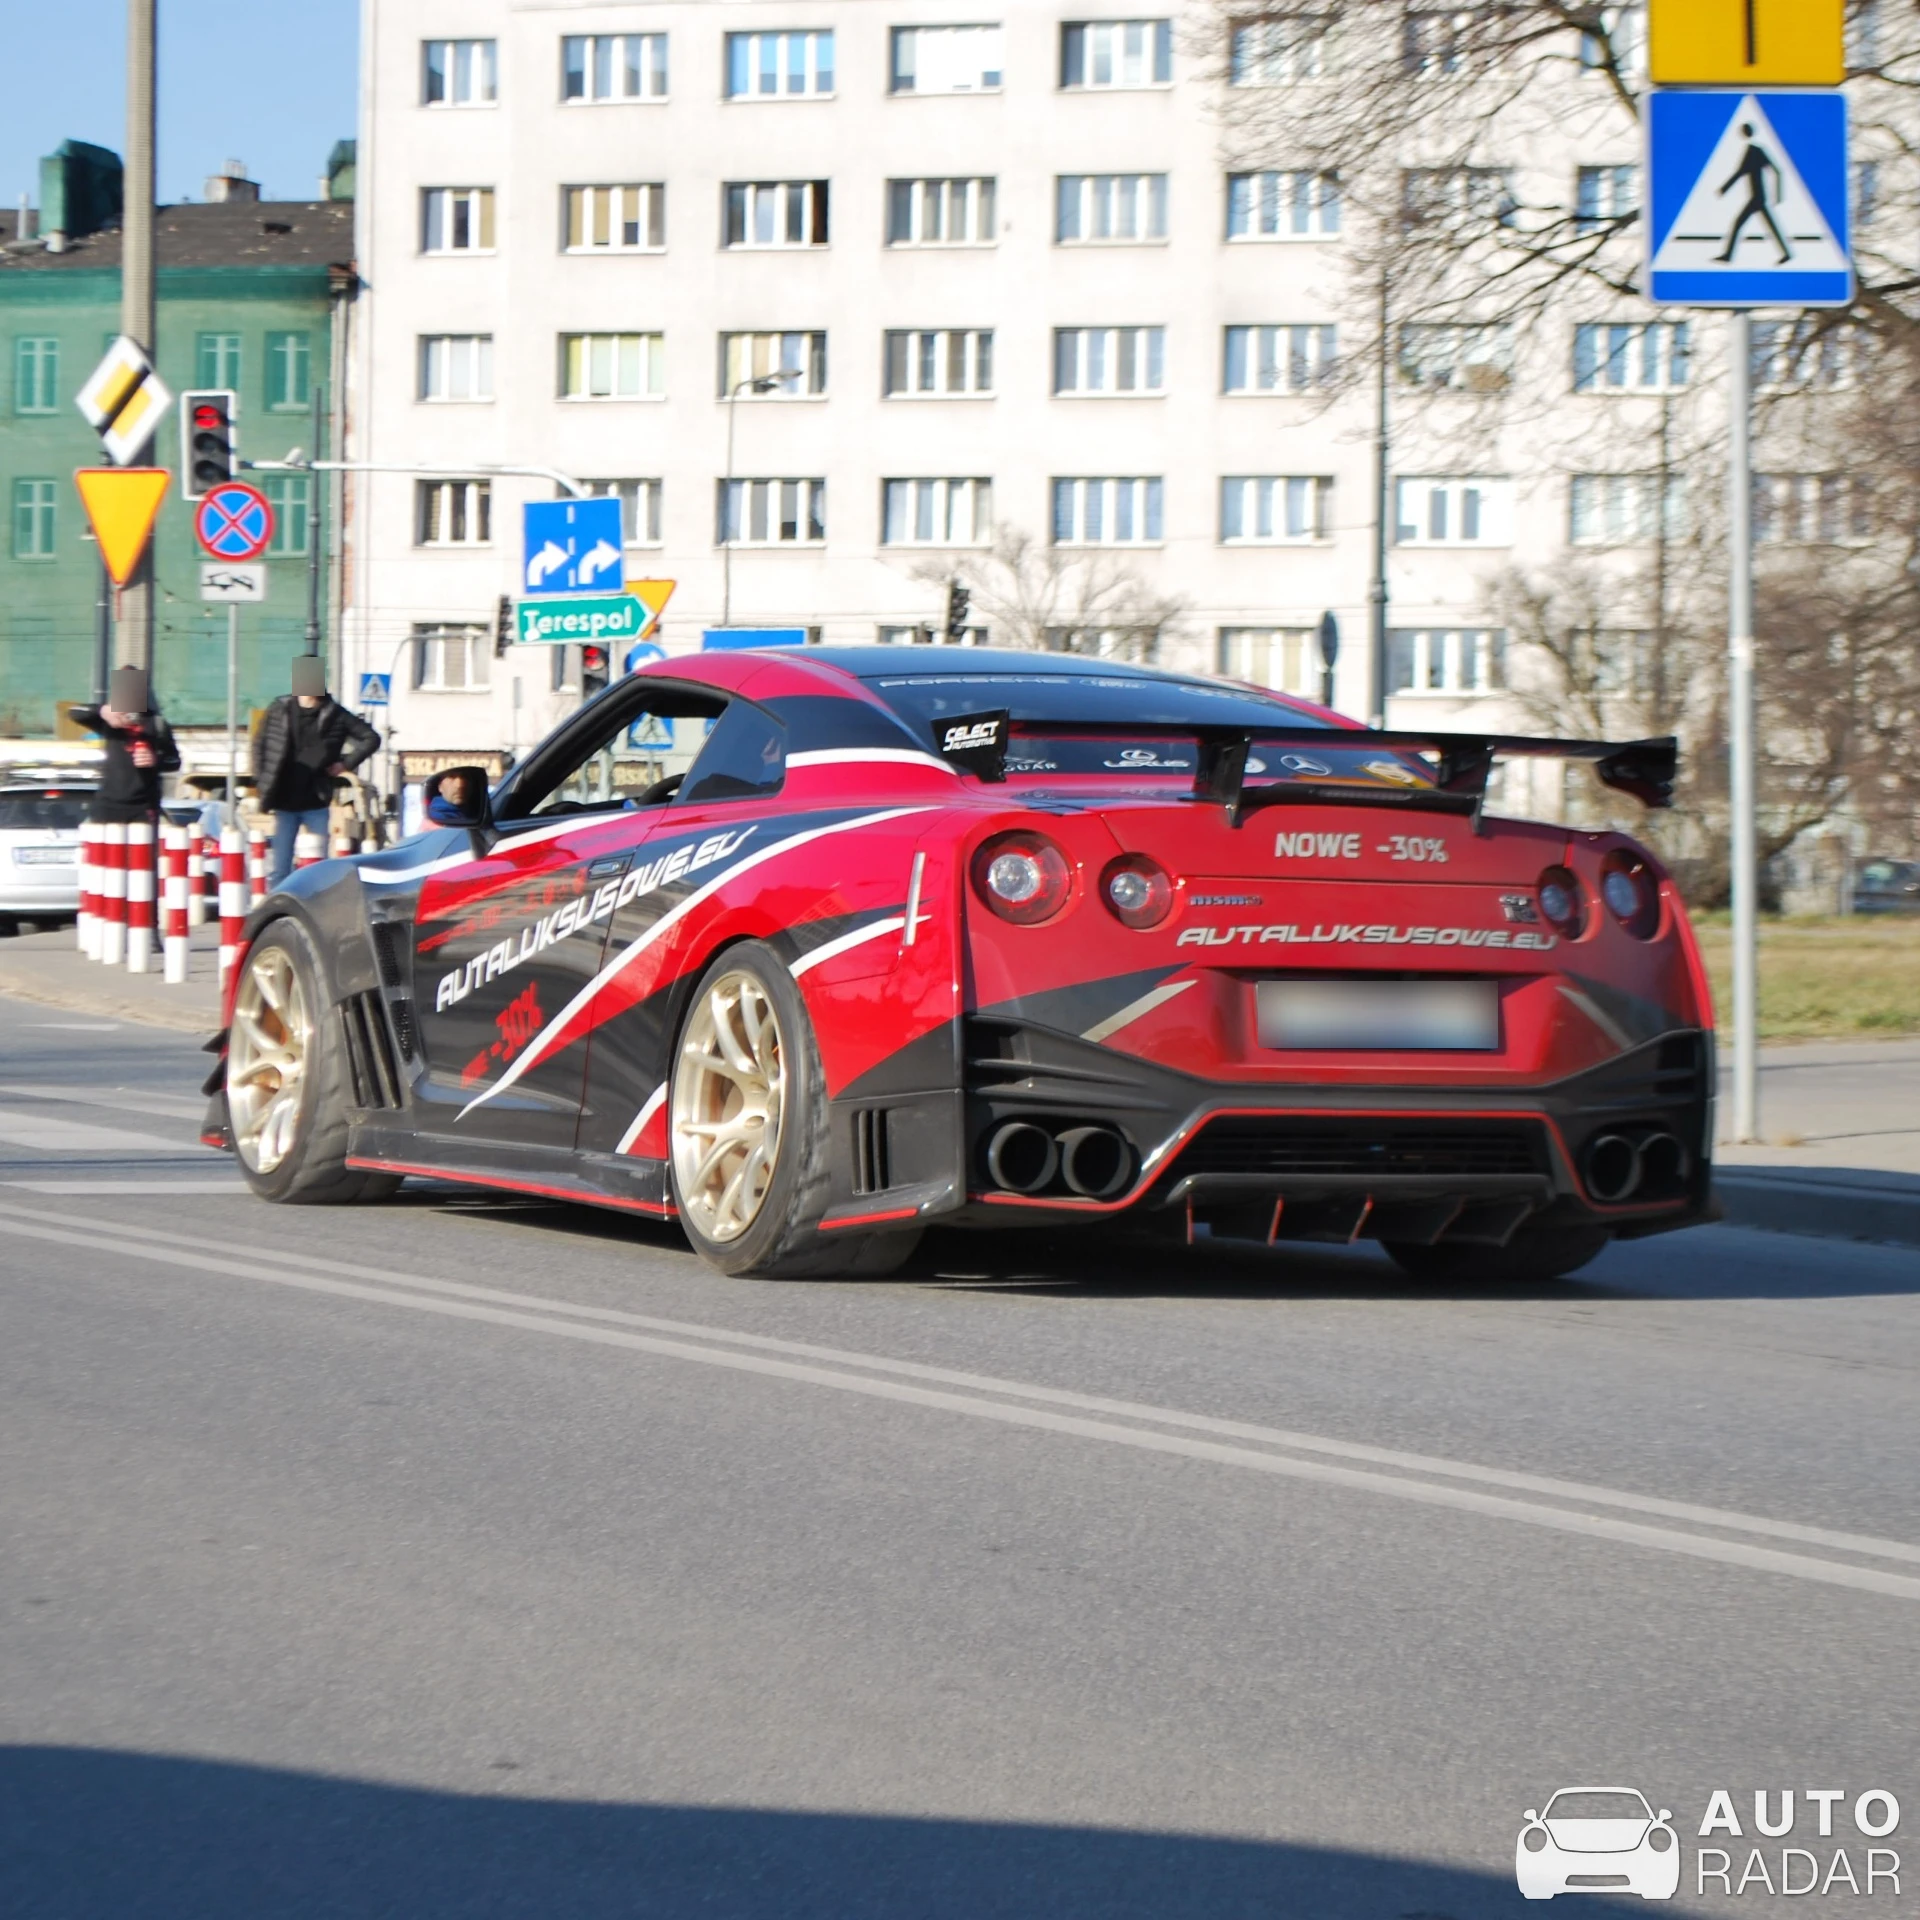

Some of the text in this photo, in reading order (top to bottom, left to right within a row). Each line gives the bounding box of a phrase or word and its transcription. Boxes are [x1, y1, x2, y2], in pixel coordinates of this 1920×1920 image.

[523, 604, 632, 638] Terespol
[942, 720, 1000, 752] SELECT
[1274, 832, 1450, 863] NOWE -30%
[436, 824, 759, 1013] AUTALUKSUSOWE.EU
[1176, 924, 1558, 951] AUTALUKSUSOWE.EU
